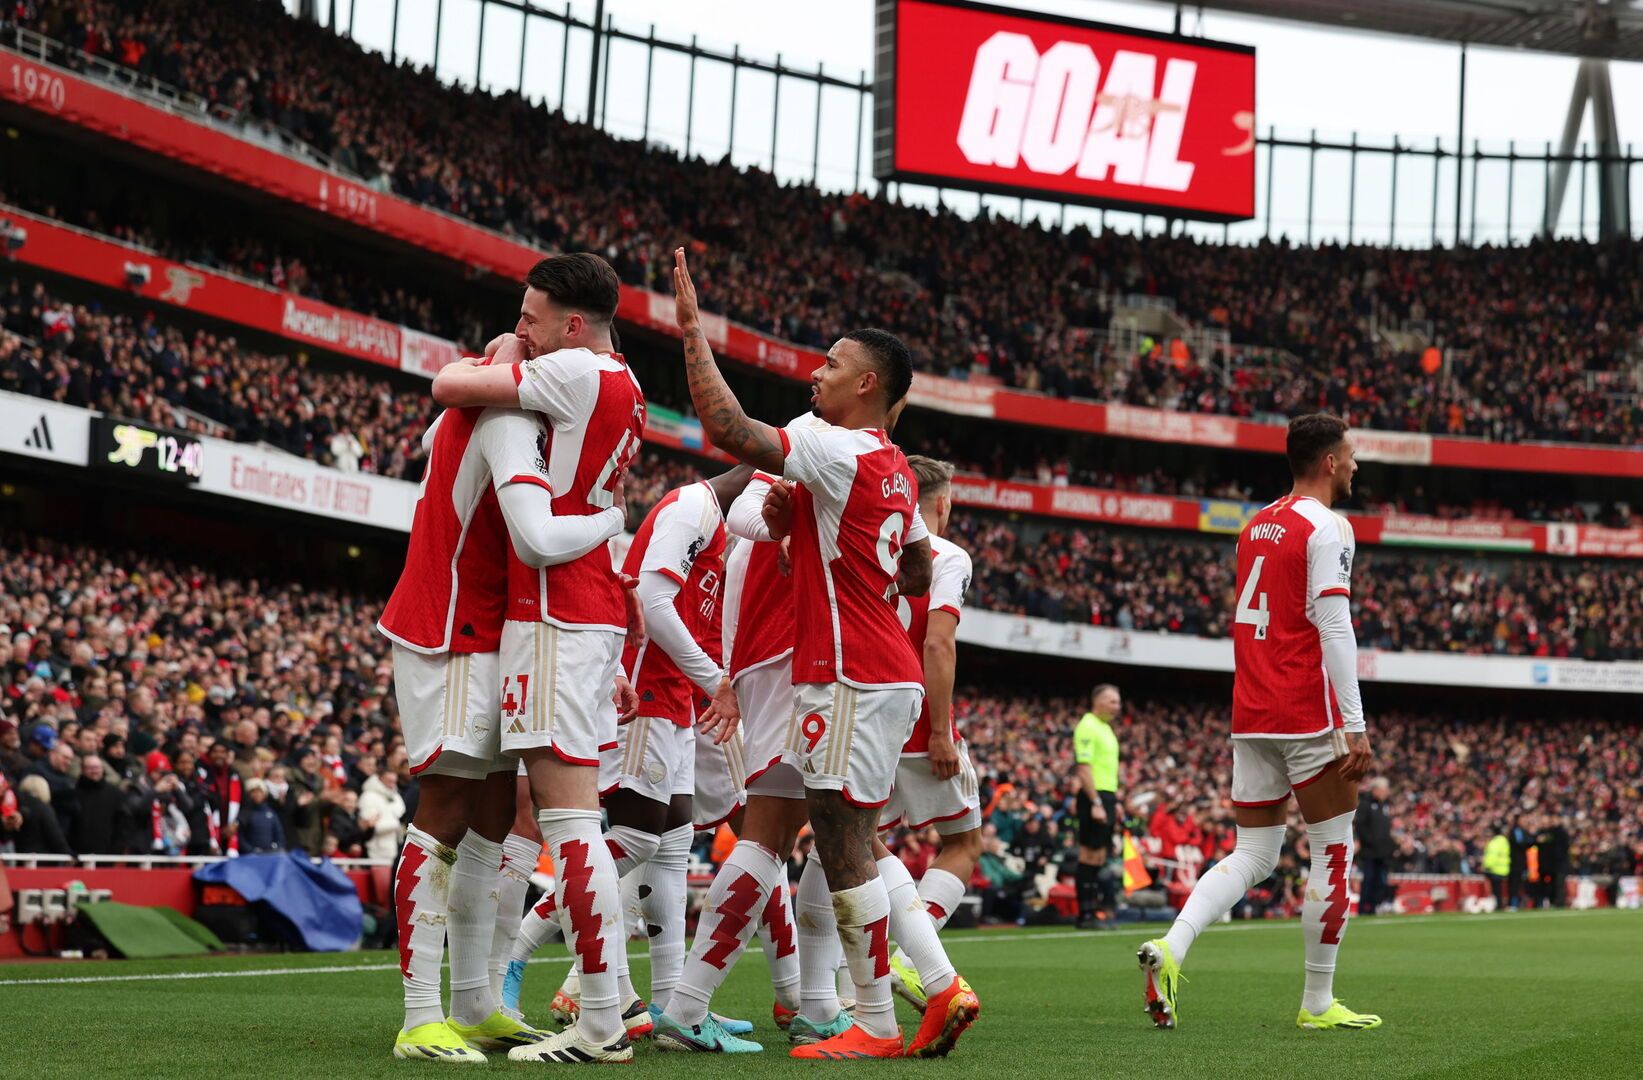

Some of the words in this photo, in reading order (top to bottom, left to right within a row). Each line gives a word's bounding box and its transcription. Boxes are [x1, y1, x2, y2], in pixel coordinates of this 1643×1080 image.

[11, 64, 65, 111] 1970
[956, 30, 1197, 192] GOAL
[156, 436, 203, 477] 12:40
[230, 454, 307, 503] Emirates
[950, 481, 1033, 510] rsenal.com
[1249, 523, 1287, 545] WHITE
[1234, 556, 1271, 640] 4
[501, 674, 529, 718] 41
[801, 713, 826, 754] 9
